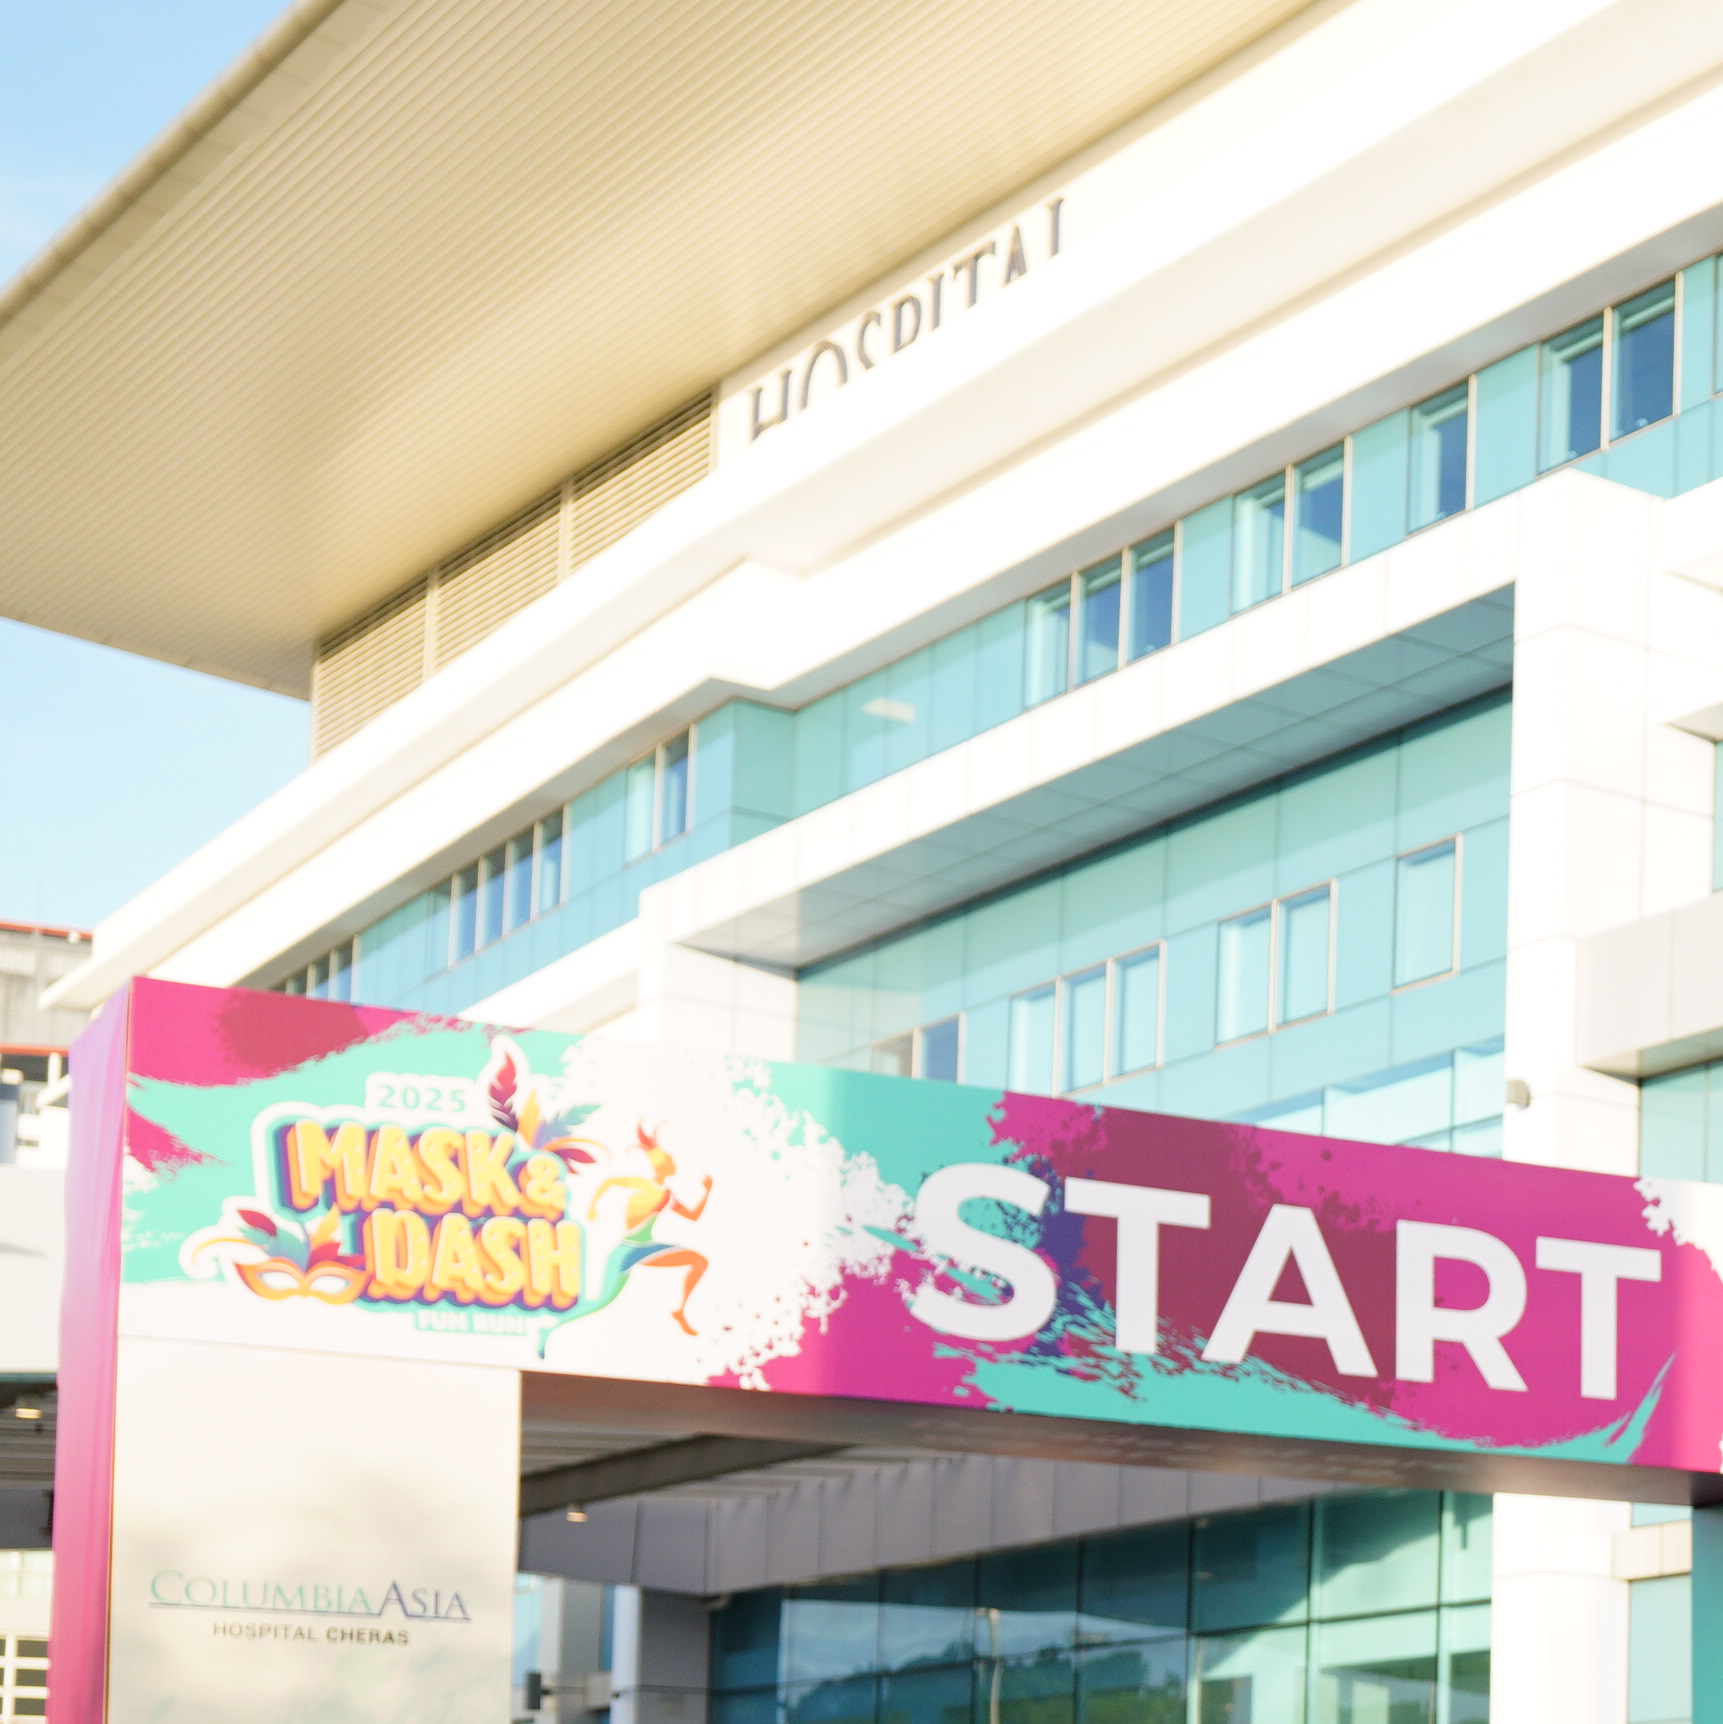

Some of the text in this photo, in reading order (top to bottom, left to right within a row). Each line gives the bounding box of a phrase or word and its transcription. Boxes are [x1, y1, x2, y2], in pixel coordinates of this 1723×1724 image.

[376, 1081, 468, 1114] 2025
[282, 1119, 522, 1220] MASK
[366, 1208, 581, 1310] DASH
[909, 1161, 1662, 1400] START
[419, 1310, 527, 1334] FUN RUN
[149, 1570, 469, 1620] COLUMBIA ASIA
[212, 1621, 410, 1646] HOSPITAL CHERAS
